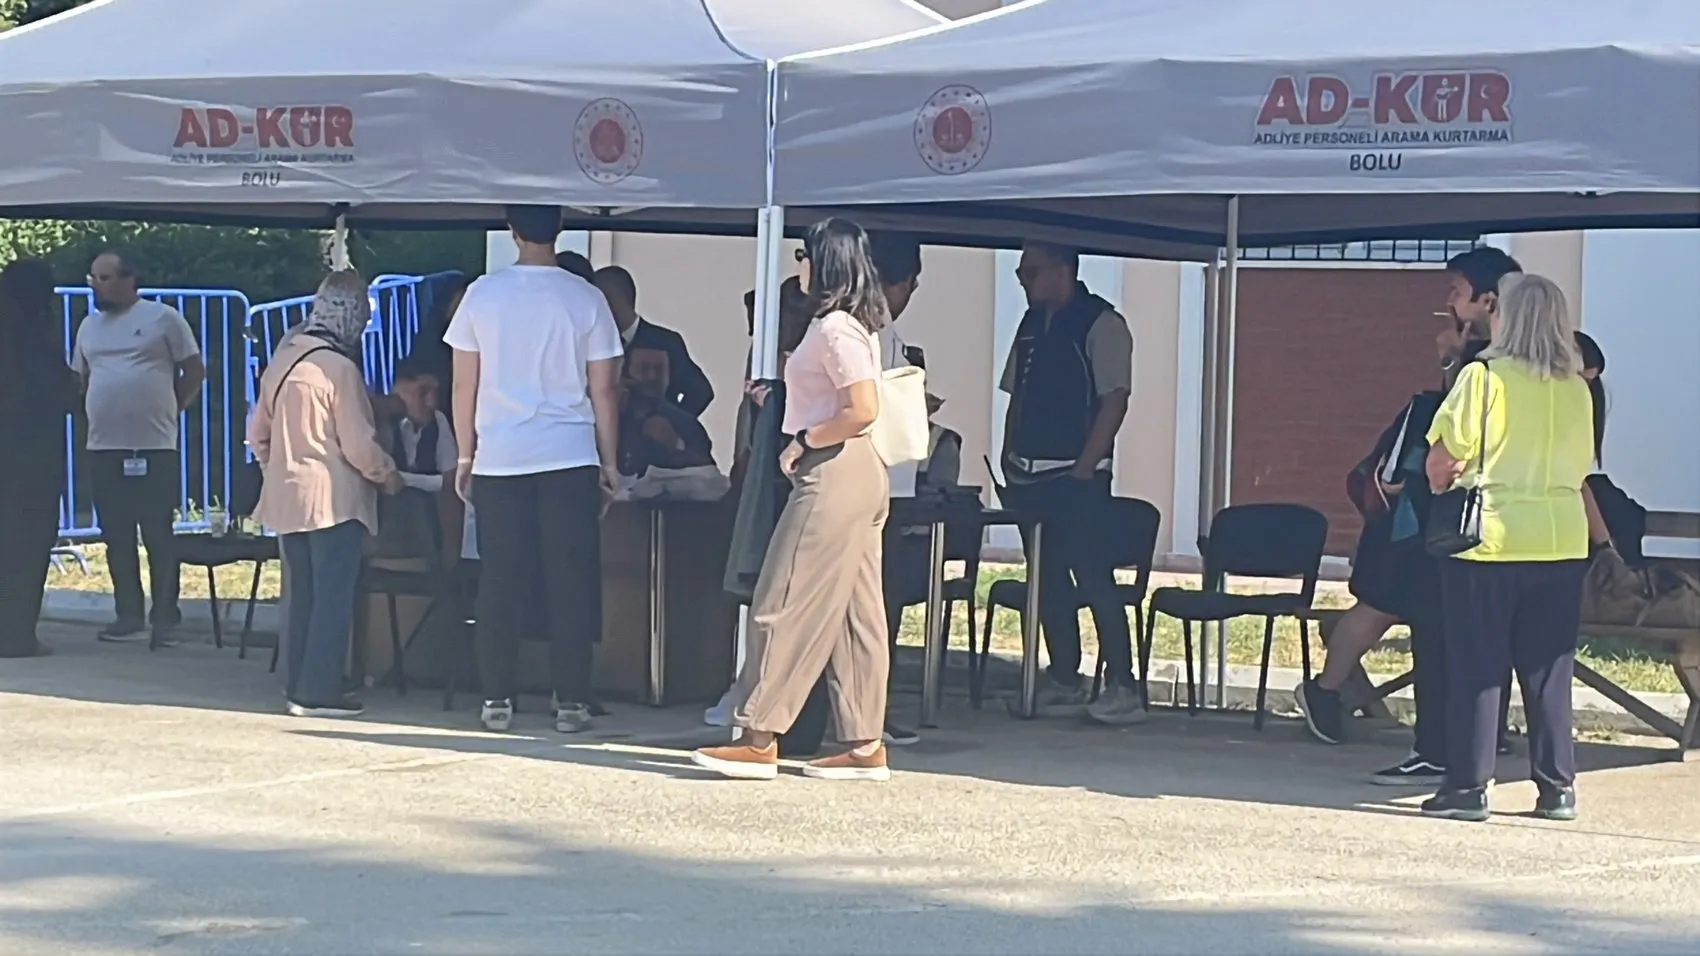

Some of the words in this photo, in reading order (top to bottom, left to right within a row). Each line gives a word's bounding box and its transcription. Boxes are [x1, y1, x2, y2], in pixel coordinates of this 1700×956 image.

[1253, 131, 1301, 145] ADLİYE
[1303, 129, 1378, 146] PERSONELİ
[1381, 130, 1430, 144] ARAMA
[1433, 129, 1509, 143] KURTARMA
[1349, 152, 1402, 172] BOLU
[241, 171, 281, 187] BOLU
